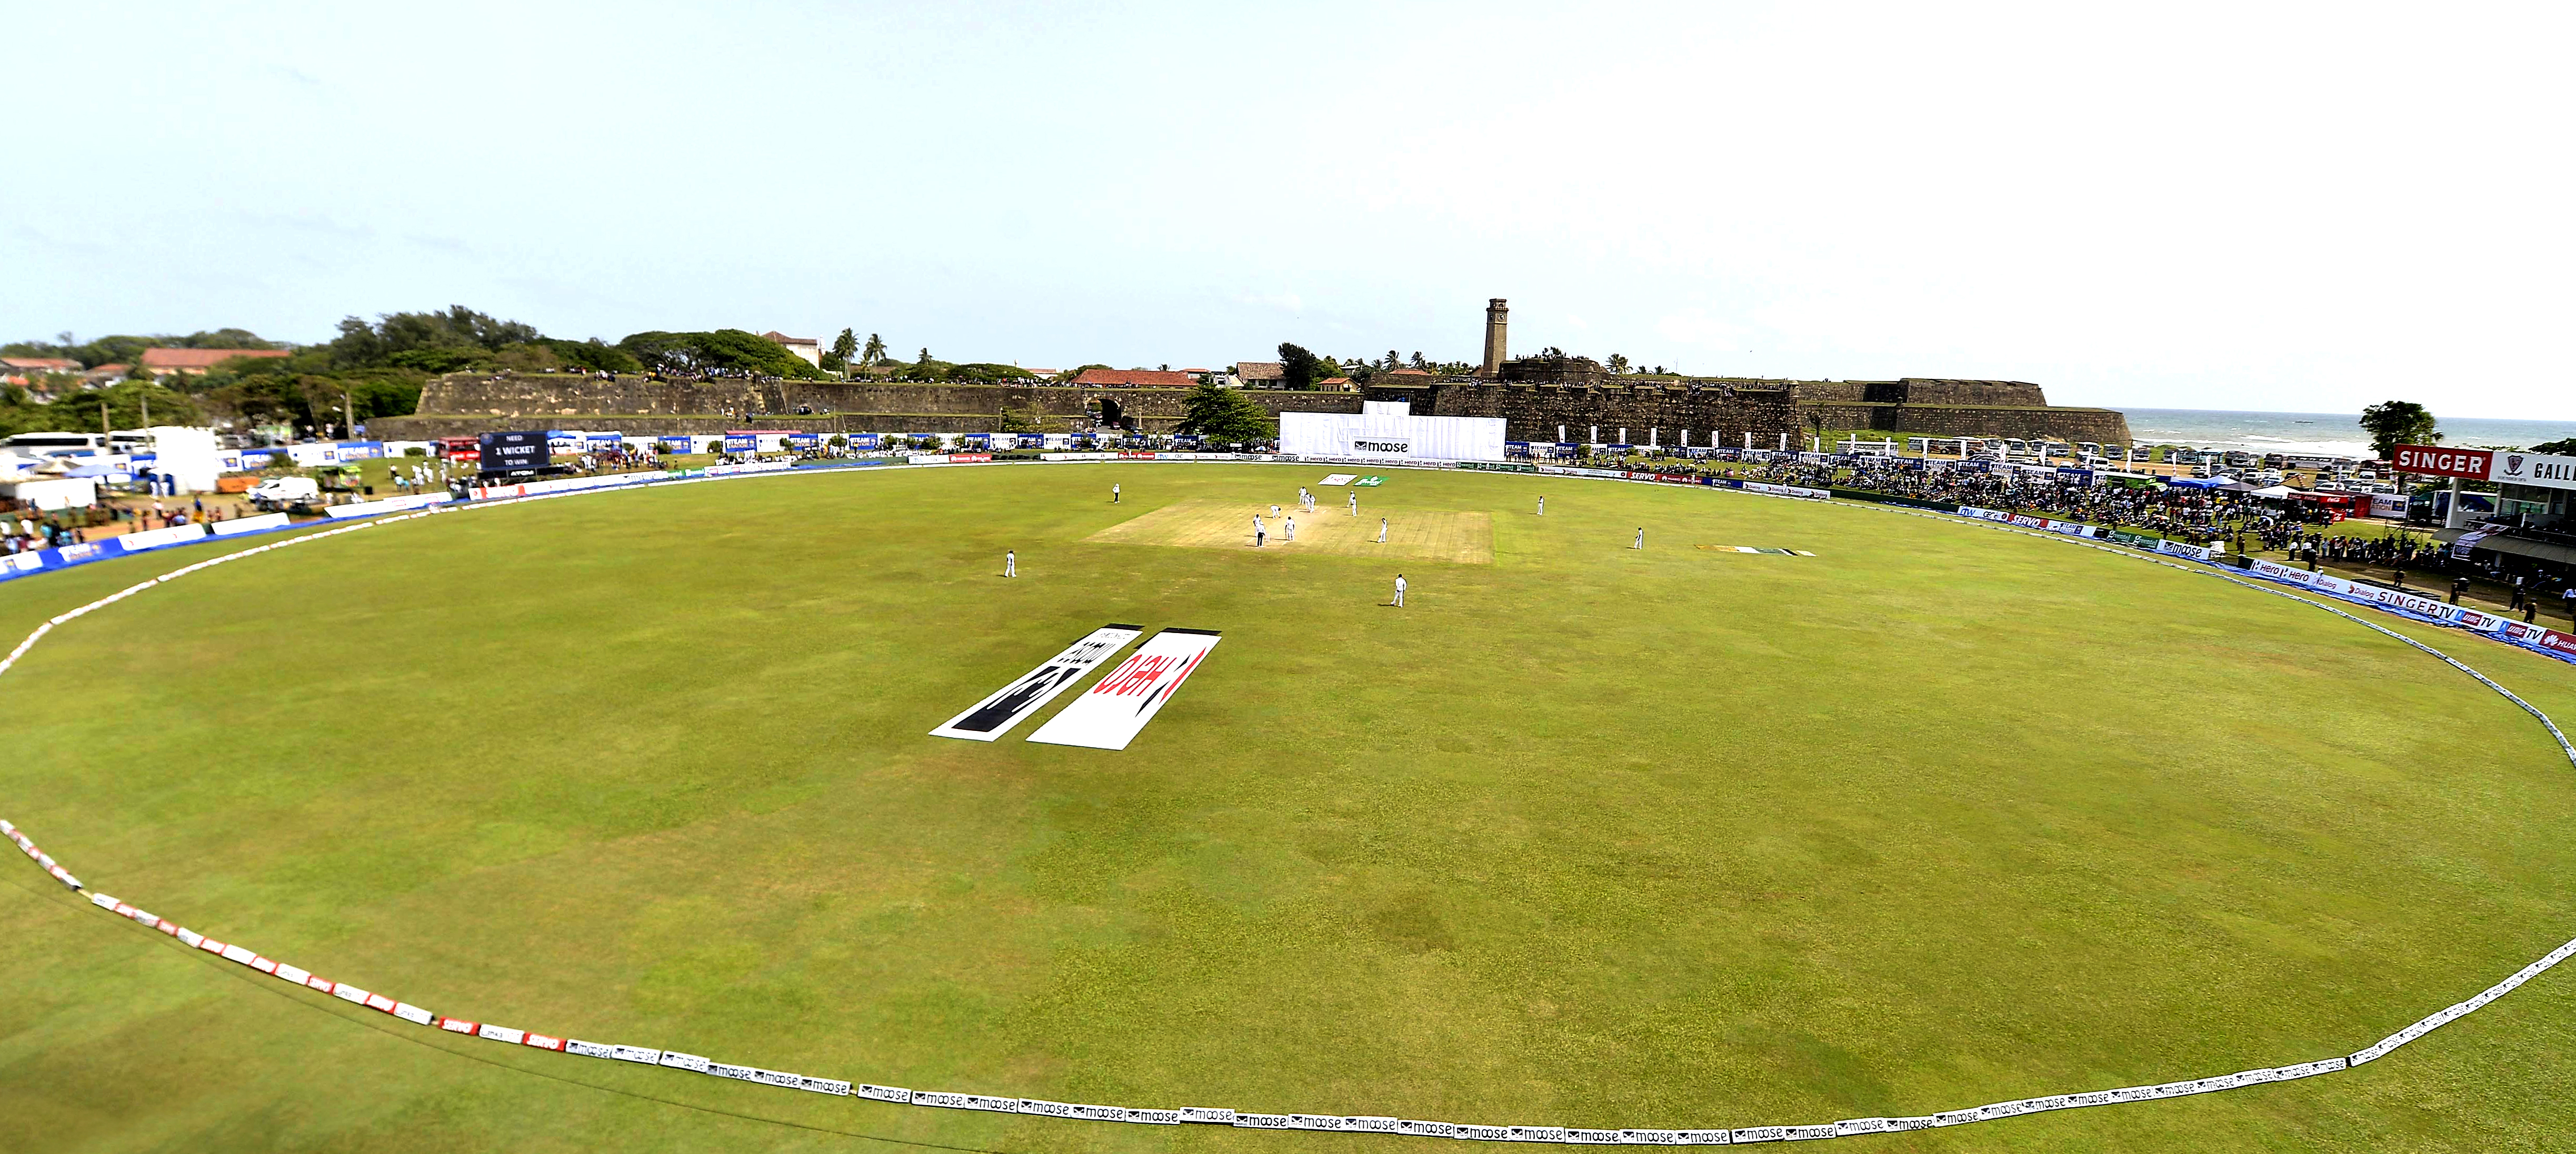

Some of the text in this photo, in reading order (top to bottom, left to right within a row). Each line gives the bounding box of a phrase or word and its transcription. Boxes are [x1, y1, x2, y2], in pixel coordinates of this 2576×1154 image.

[502, 446, 535, 455] WICKET
[1369, 441, 1408, 453] moose
[2399, 450, 2483, 474] SINGER
[1632, 472, 1655, 480] SERVO
[2012, 515, 2040, 526] SERVO
[2173, 544, 2202, 558] moose
[2260, 564, 2279, 575] Hero
[2290, 571, 2310, 581] Hero
[2319, 579, 2337, 589] Dialog
[2354, 587, 2374, 599] Dialog
[2378, 591, 2455, 619] SINGER TV
[2481, 617, 2495, 628] TV
[2527, 628, 2542, 640] TV
[2558, 639, 2576, 651] HUA
[442, 1020, 472, 1032] SERVO
[528, 1035, 559, 1049] SERVO
[2284, 1065, 2311, 1077] moose
[2320, 1059, 2344, 1071] moose
[718, 1066, 751, 1079] moose
[2245, 1070, 2272, 1083] moose
[765, 1072, 798, 1086] moose
[2206, 1077, 2234, 1090] moose
[813, 1080, 847, 1093] moose
[2164, 1083, 2194, 1095] moose
[873, 1087, 908, 1100] moose
[2079, 1093, 2109, 1105] moose
[2122, 1088, 2152, 1100] moose
[926, 1094, 963, 1106] moose
[980, 1099, 1015, 1111] moose
[2035, 1097, 2065, 1110] moose
[1033, 1102, 1069, 1115] moose
[1086, 1108, 1123, 1119] moose
[1195, 1109, 1232, 1120] moose
[1991, 1103, 2022, 1117] moose
[1141, 1111, 1178, 1122] moose
[1250, 1116, 1286, 1127] moose
[1304, 1117, 1341, 1128] moose
[1948, 1111, 1978, 1124] moose
[1359, 1119, 1395, 1130] moose
[1414, 1122, 1452, 1134] moose
[1849, 1119, 1884, 1132] moose
[1899, 1119, 1933, 1130] moose
[1470, 1127, 1507, 1139] moose
[1525, 1129, 1562, 1140] moose
[1581, 1131, 1619, 1142] moose
[1636, 1131, 1673, 1142] moose
[1691, 1132, 1728, 1142] moose
[1748, 1128, 1783, 1140] moose
[1799, 1127, 1833, 1139] moose
